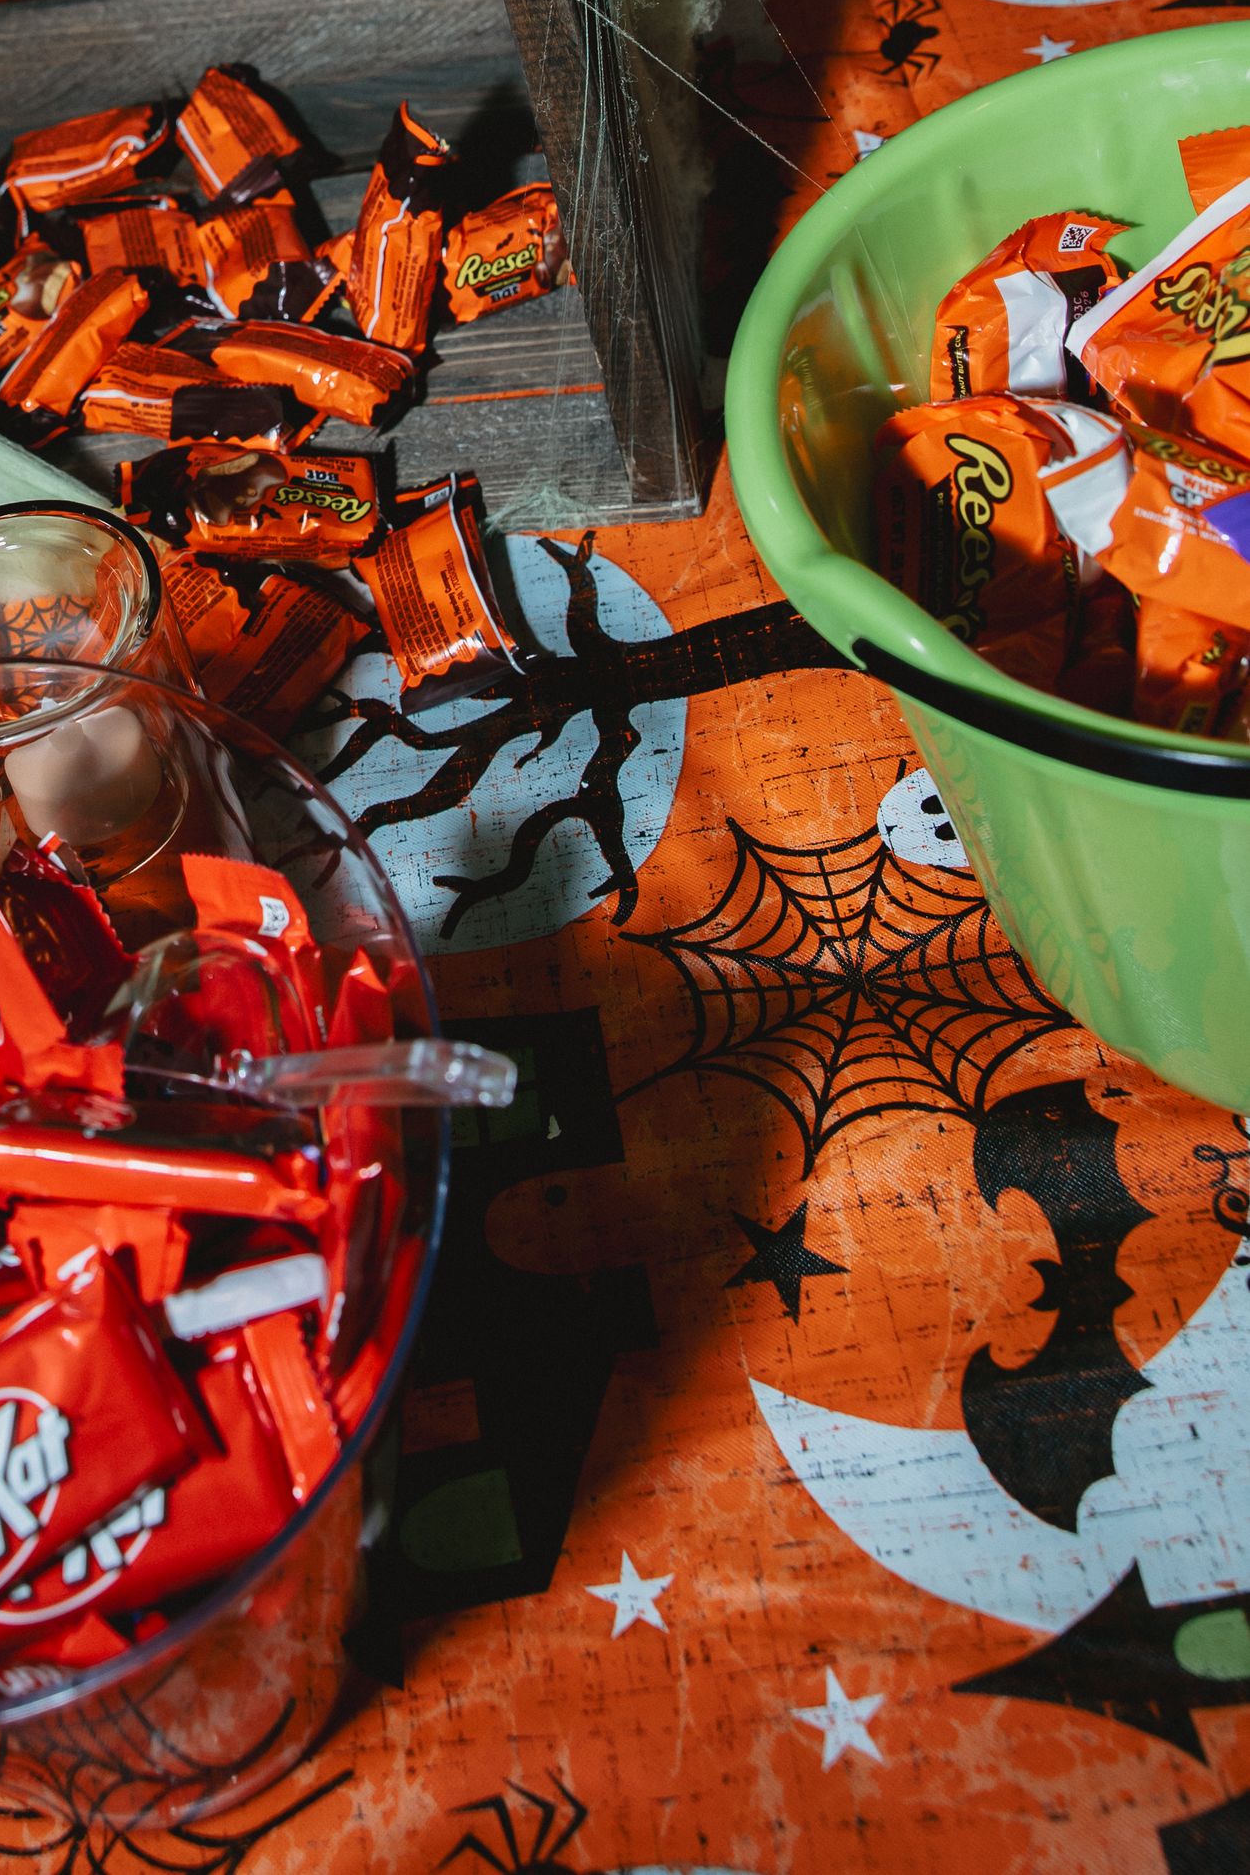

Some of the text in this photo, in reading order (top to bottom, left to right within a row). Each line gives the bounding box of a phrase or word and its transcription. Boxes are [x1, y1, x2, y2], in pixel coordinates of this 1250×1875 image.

[455, 242, 538, 290] Reese's
[306, 468, 340, 484] Bat
[275, 486, 374, 523] Reese's
